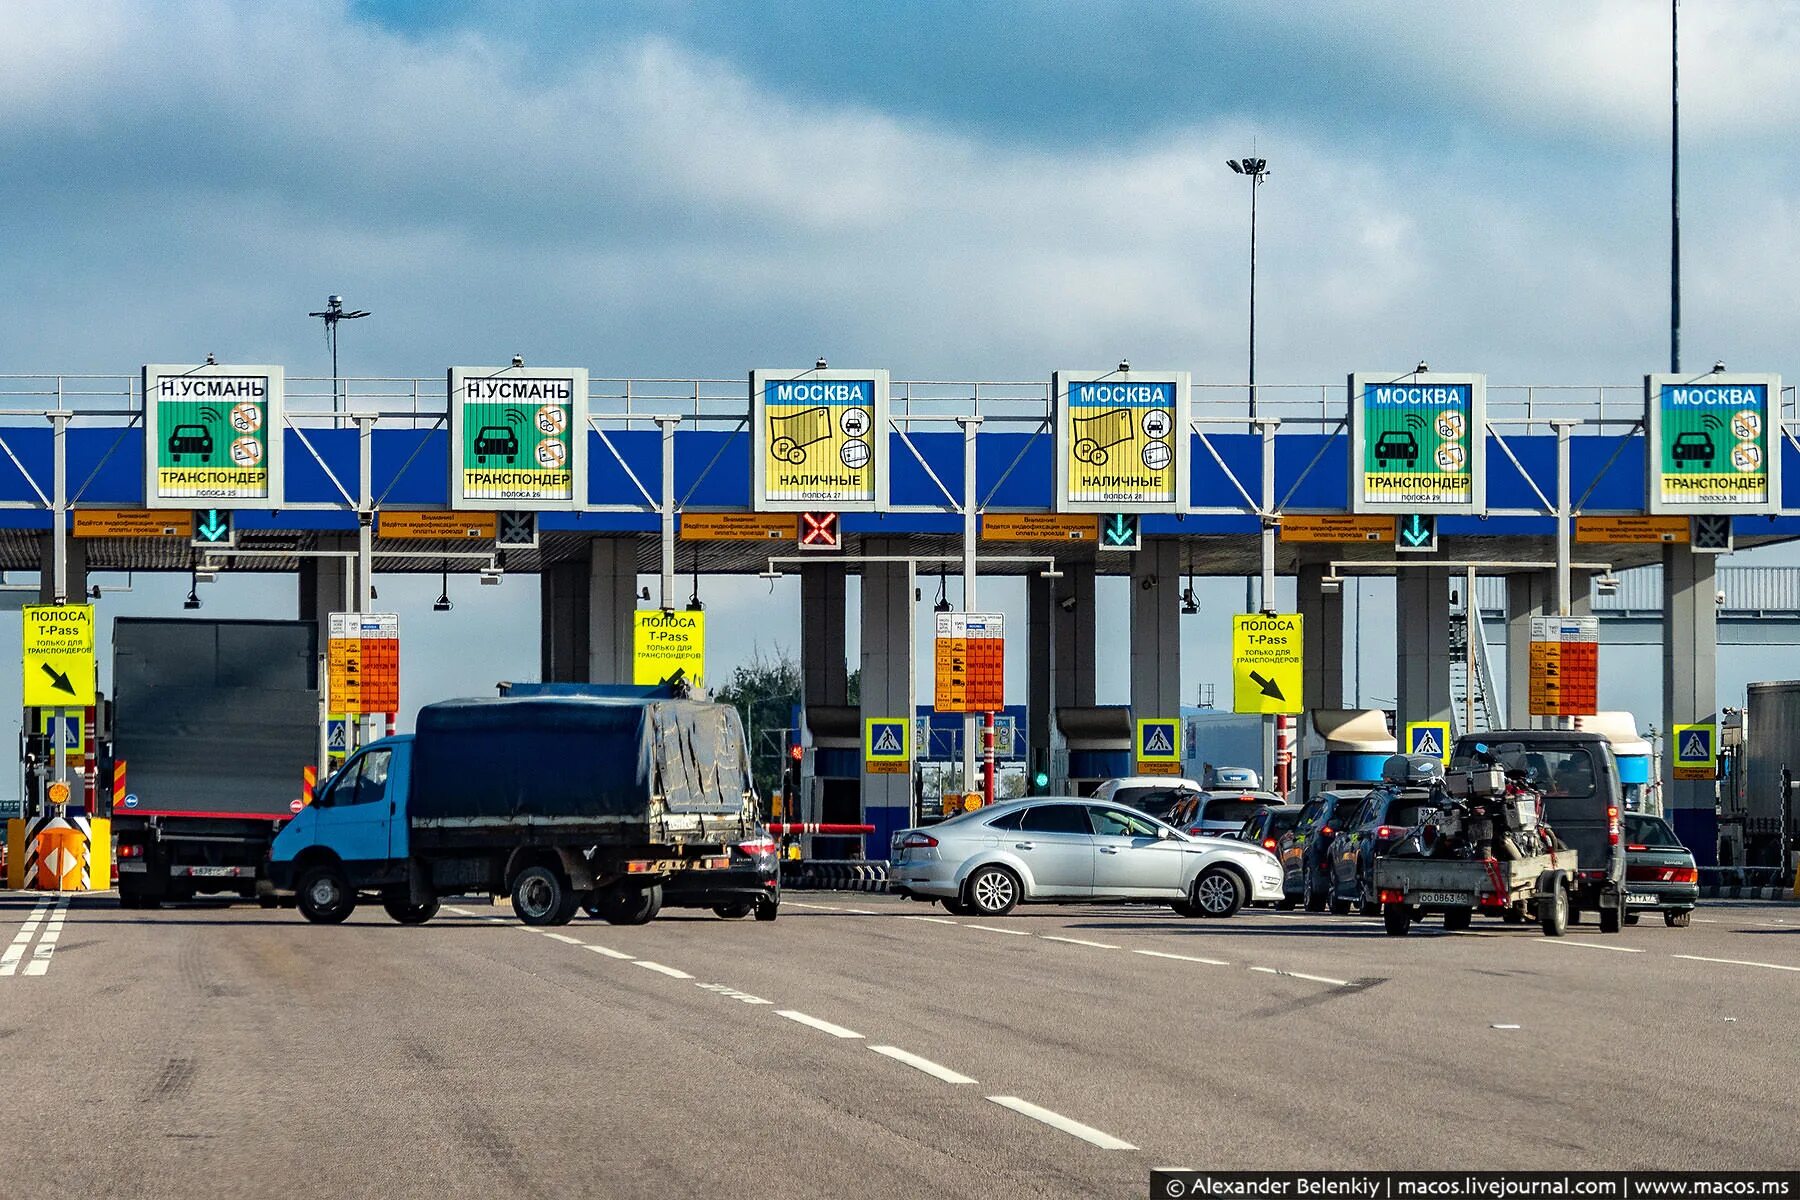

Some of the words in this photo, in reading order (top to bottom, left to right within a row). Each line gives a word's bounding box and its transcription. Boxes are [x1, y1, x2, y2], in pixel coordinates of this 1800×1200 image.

[162, 382, 264, 397] Н.УСМАНЬ
[468, 384, 569, 398] Н.УСМАНЬ
[778, 385, 863, 400] МОСКВА
[1081, 387, 1165, 402] МОСКВА
[1377, 389, 1461, 404] МОСКВА
[1674, 390, 1756, 404] МОСКВА
[161, 472, 265, 485] ТРАНСПОНДЕР
[466, 474, 570, 486] ТРАНСПОНДЕР
[780, 475, 860, 485] НАЛИЧНЫЕ
[1083, 476, 1161, 486] НАЛИЧНЫЕ
[1368, 477, 1469, 489] ТРАНСПОНДЕР
[1665, 478, 1765, 489] ТРАНСПОНДЕР
[32, 612, 86, 621] ПОЛОСА
[642, 618, 695, 627] ПОЛОСА
[1242, 621, 1294, 630] ПОЛОСА
[39, 626, 79, 635] T-Pass
[649, 632, 688, 641] T-Pass
[1248, 635, 1287, 644] T-Pass
[1434, 894, 1455, 902] 0863
